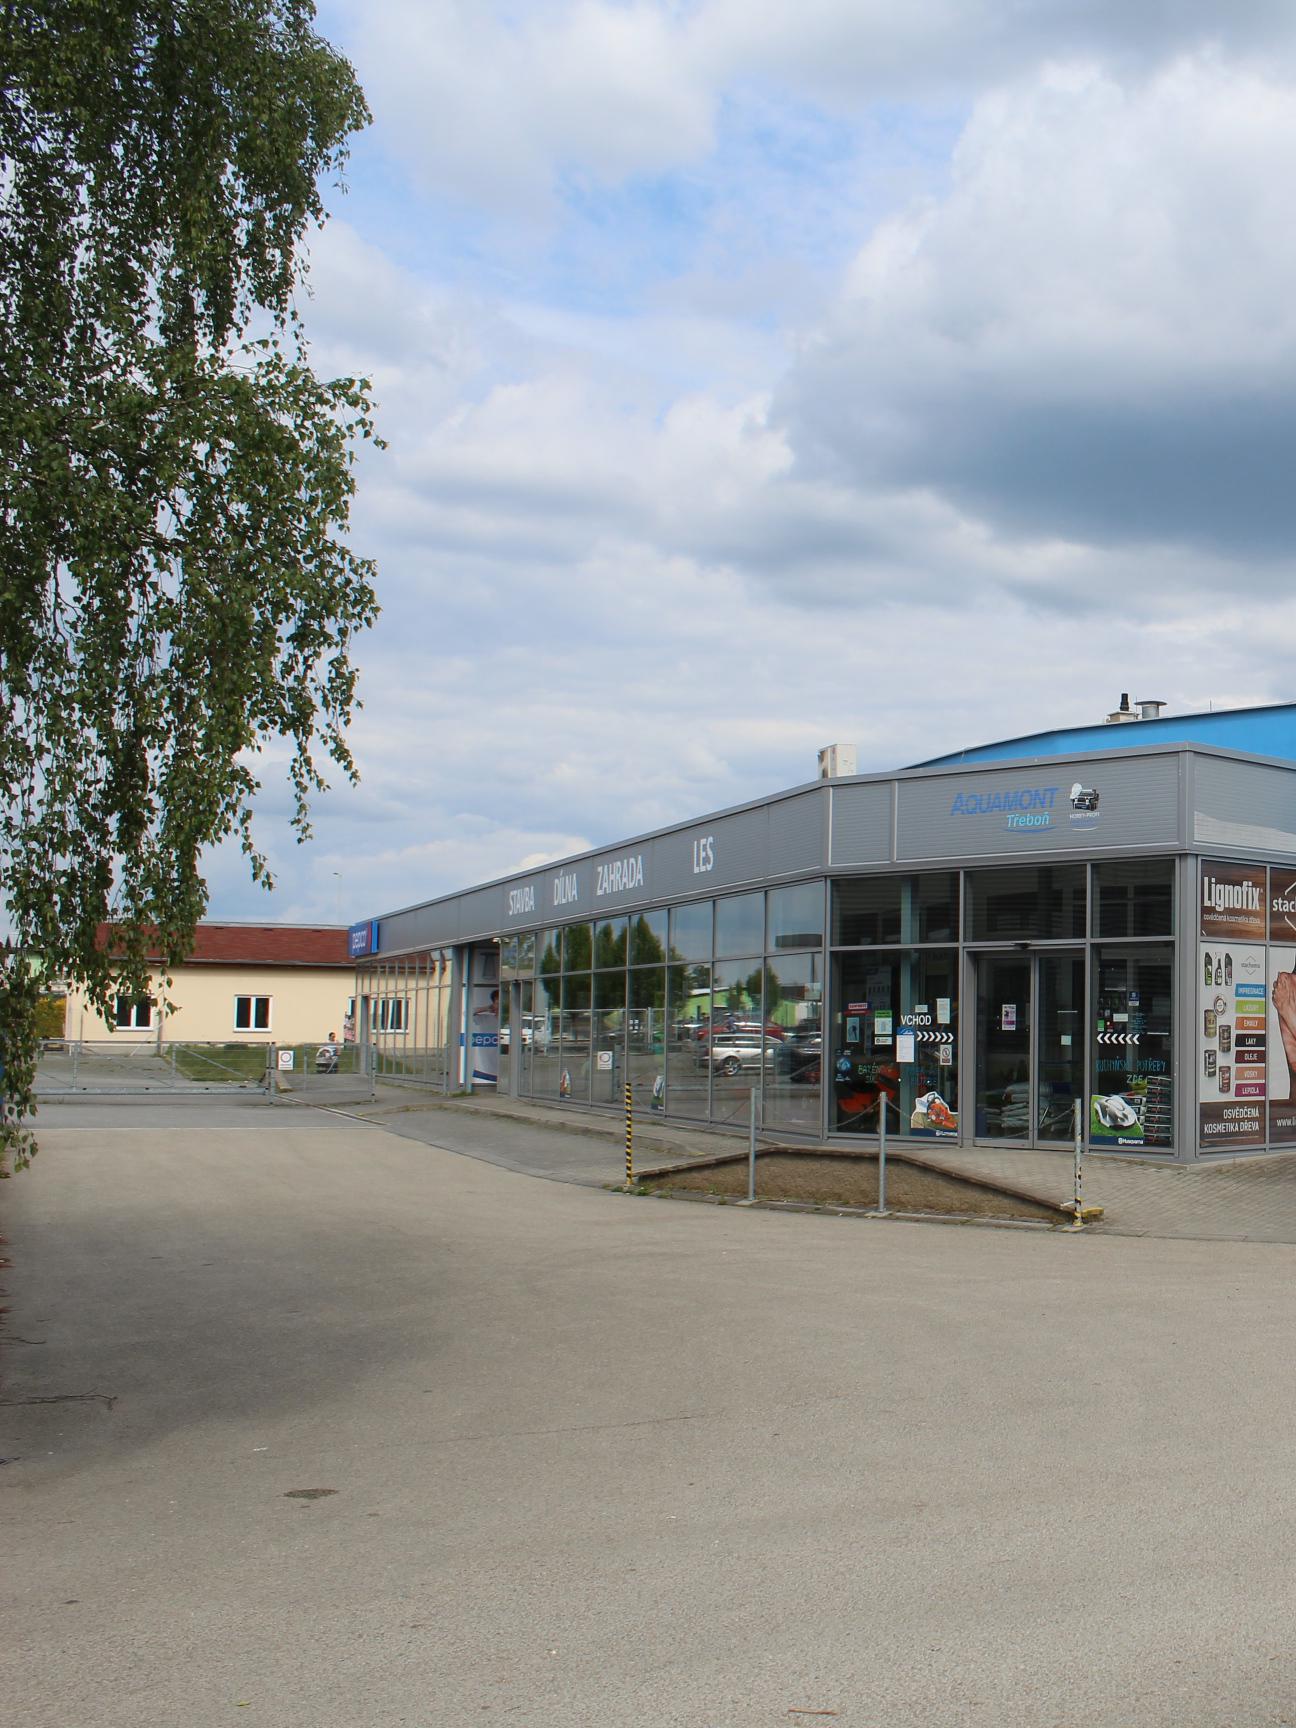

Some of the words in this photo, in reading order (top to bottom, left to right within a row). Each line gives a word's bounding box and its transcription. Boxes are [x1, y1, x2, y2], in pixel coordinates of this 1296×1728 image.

[950, 787, 1059, 816] AQUAMONT
[1006, 811, 1050, 828] Třeboň
[693, 836, 714, 874] LES
[553, 868, 578, 906] DÍLNA
[596, 855, 644, 896] ZAHRADA
[508, 885, 535, 916] STAVBA
[1203, 876, 1260, 912] Lignofix
[901, 1014, 932, 1026] VCHOD
[1204, 1122, 1239, 1134] KOSMETIKA
[1240, 1120, 1260, 1132] DŘEVA
[1223, 1106, 1260, 1119] OSVĚDČENÁ
